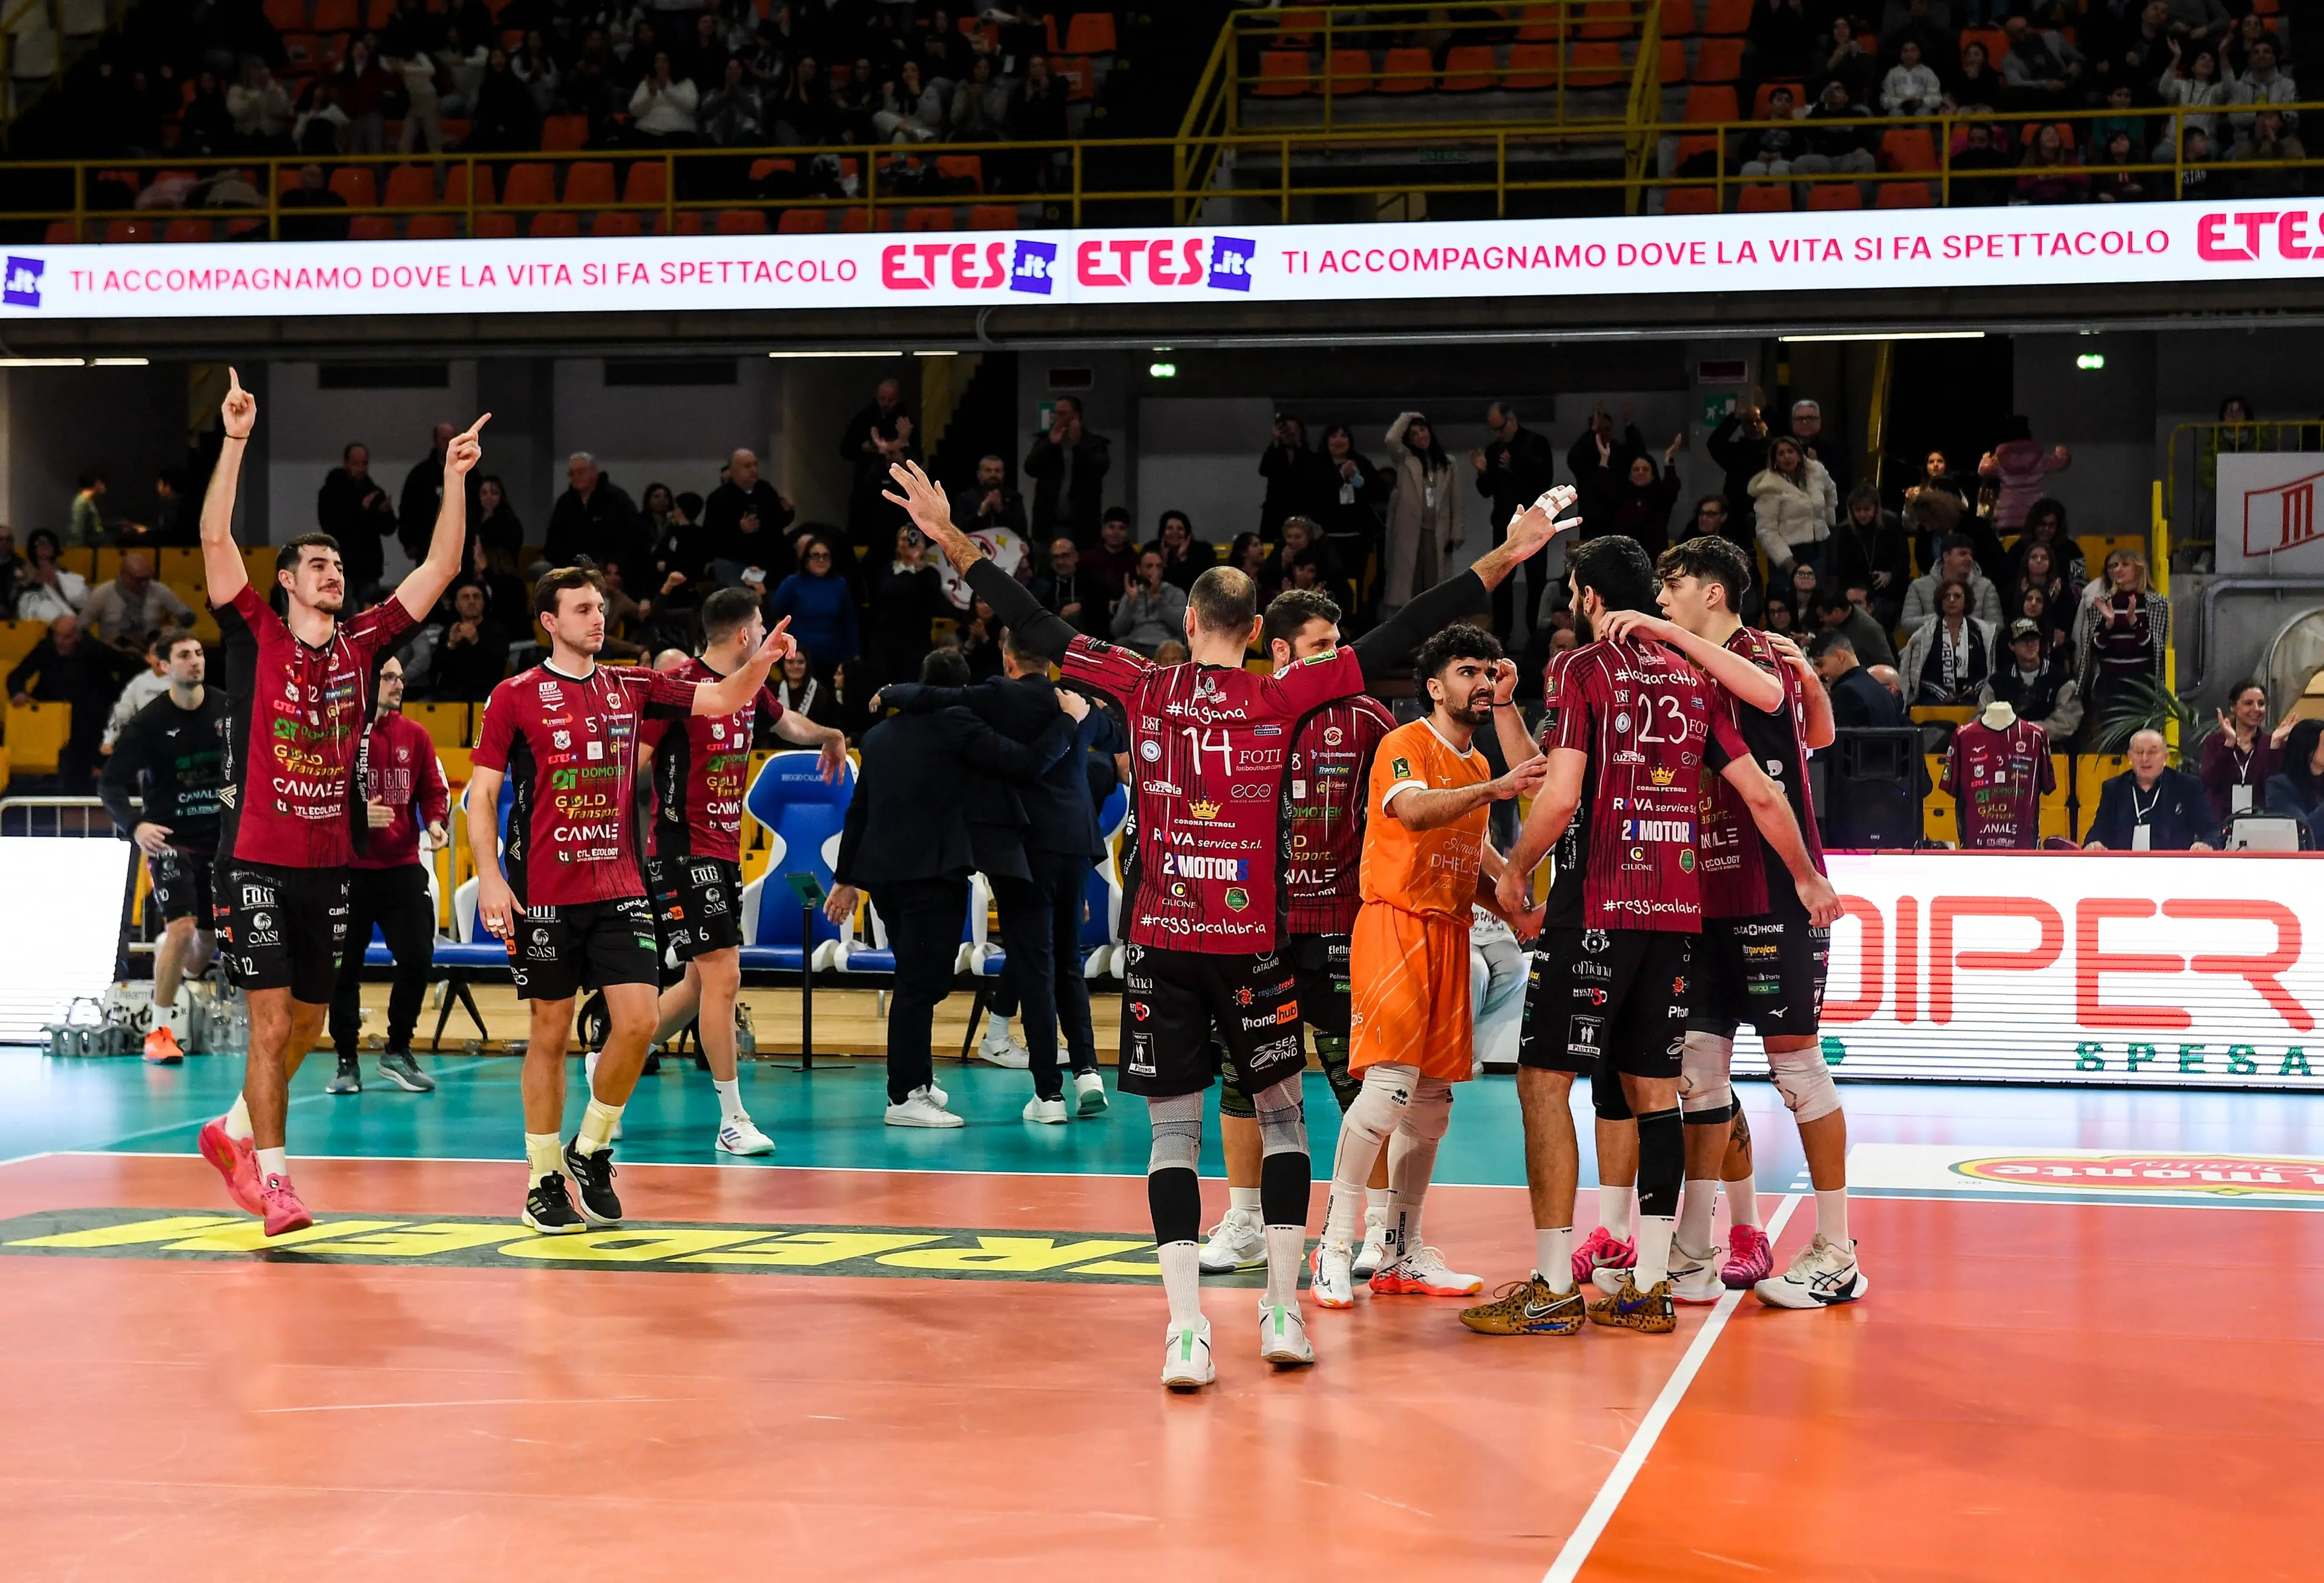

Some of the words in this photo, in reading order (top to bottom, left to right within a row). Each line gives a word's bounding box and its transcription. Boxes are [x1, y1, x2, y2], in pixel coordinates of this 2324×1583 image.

[1281, 251, 1308, 274] TI
[1319, 243, 1606, 274] ACCOMPAGNAMO
[1617, 241, 1706, 266] DOVE
[1717, 240, 1758, 264] LA
[1768, 239, 1843, 263] VITA
[1854, 237, 1882, 261] SI
[1893, 236, 1932, 260] FA
[1942, 230, 2169, 260] SPETTACOLO
[881, 242, 1006, 290] ETES
[1077, 238, 1203, 286] ETES
[70, 270, 93, 293] TI
[104, 267, 362, 292] ACCOMPAGNAMO
[372, 265, 451, 289] DOVE
[461, 264, 497, 287] LA
[507, 264, 573, 287] VITA
[583, 263, 606, 286] SI
[617, 263, 650, 285] FA
[659, 259, 857, 284] SPETTACOLO
[1614, 668, 1698, 687] #lazzaretto
[307, 684, 320, 703] 12
[585, 716, 598, 733] 5
[1637, 693, 1688, 744] 23
[548, 753, 570, 764] ETES
[1182, 726, 1233, 777] 14
[1239, 749, 1281, 764] FOTI
[1292, 753, 1302, 770] 8
[1997, 756, 2004, 767] 3
[272, 777, 346, 798] CANALE
[1231, 784, 1271, 798] eco
[555, 793, 606, 808] GOLD
[1655, 804, 1690, 813] service
[554, 823, 619, 842] CANALE
[591, 847, 619, 856] ECOLOGY
[1197, 839, 1238, 850] service
[1239, 839, 1262, 850] S.r.l.
[704, 900, 727, 914] OASI
[1161, 898, 1196, 909] CILIONE
[1140, 913, 1266, 935] #reggiocalabria
[1758, 924, 1784, 934] PHONE
[249, 930, 278, 943] OASI
[699, 926, 710, 942] 6
[527, 946, 556, 958] OASI
[241, 956, 259, 975] 12
[1253, 957, 1280, 974] CATALANO
[1572, 960, 1612, 977] officina
[1258, 974, 1295, 997] reggiotravel
[1276, 1035, 1297, 1050] SEA
[1270, 1047, 1298, 1062] WIND
[2075, 1041, 2313, 1077] SPESA
